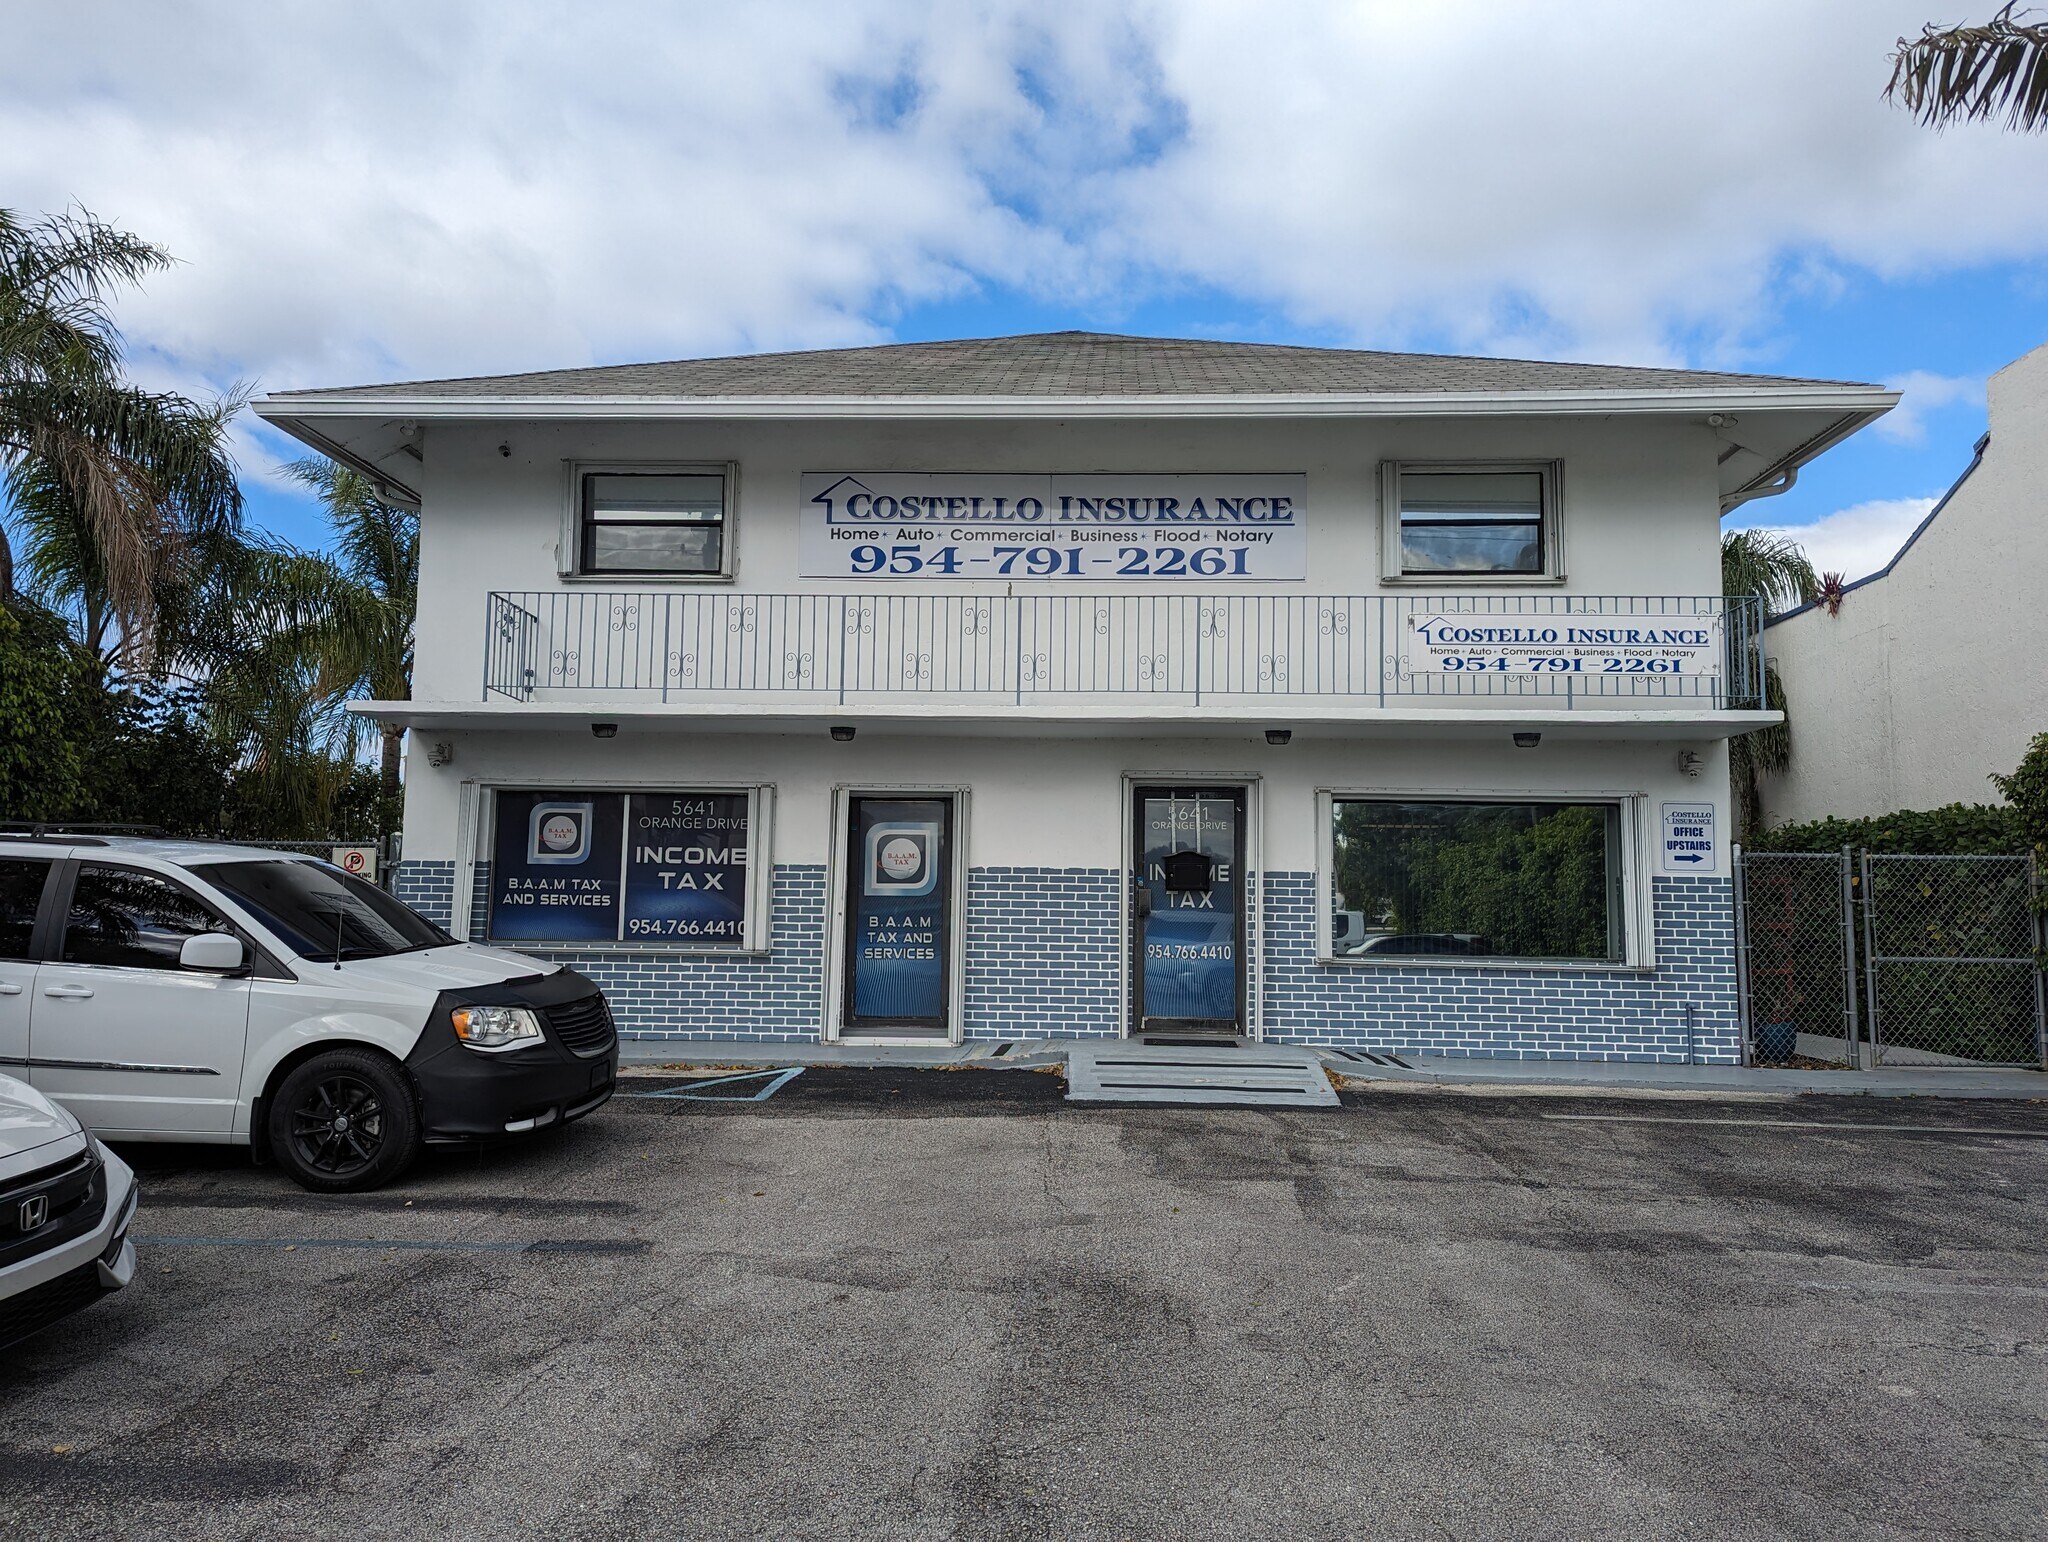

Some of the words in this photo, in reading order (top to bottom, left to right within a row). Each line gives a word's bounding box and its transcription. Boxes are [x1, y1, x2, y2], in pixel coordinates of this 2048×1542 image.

[846, 493, 1045, 522] COSTELLO
[1058, 494, 1296, 523] INSURANCE
[830, 528, 880, 541] Home
[896, 528, 935, 542] Auto
[950, 528, 1056, 542] Commercial
[1071, 529, 1138, 543] Business
[1154, 529, 1201, 543] Flood
[1216, 529, 1274, 545] Notary
[850, 544, 1252, 576] 954-791-2261
[1438, 626, 1558, 644] COSTELLO
[1567, 627, 1710, 645] INSURANCE
[1430, 647, 1460, 656] Home
[1469, 647, 1492, 656] Auto
[1501, 647, 1565, 657] Commercial
[1574, 648, 1615, 657] Business
[1624, 648, 1652, 657] Flood
[1662, 648, 1696, 659] Notary
[1442, 656, 1684, 673] 954-791-2261
[672, 800, 715, 816] 5641
[1672, 811, 1712, 819] COSTELLO
[639, 816, 702, 830] ORANGE
[706, 817, 748, 830] DRIVE
[1673, 826, 1704, 837] OFFICE
[1666, 840, 1712, 851] UPSTAIRS
[635, 846, 748, 865] INCOME
[1149, 863, 1230, 882] INE
[508, 878, 566, 891] B.A.A.M
[571, 879, 602, 891] TAX
[657, 872, 725, 891] TAX
[502, 893, 535, 905] AND
[540, 893, 611, 906] SERVICES
[1165, 890, 1214, 909] TAX
[629, 919, 746, 936] 954.766.4410
[869, 916, 932, 928] B.A.A.M
[867, 932, 898, 944] TAX
[903, 932, 933, 944] AND
[864, 947, 935, 960] SERVICES
[1147, 944, 1231, 960] 954.766.4410
